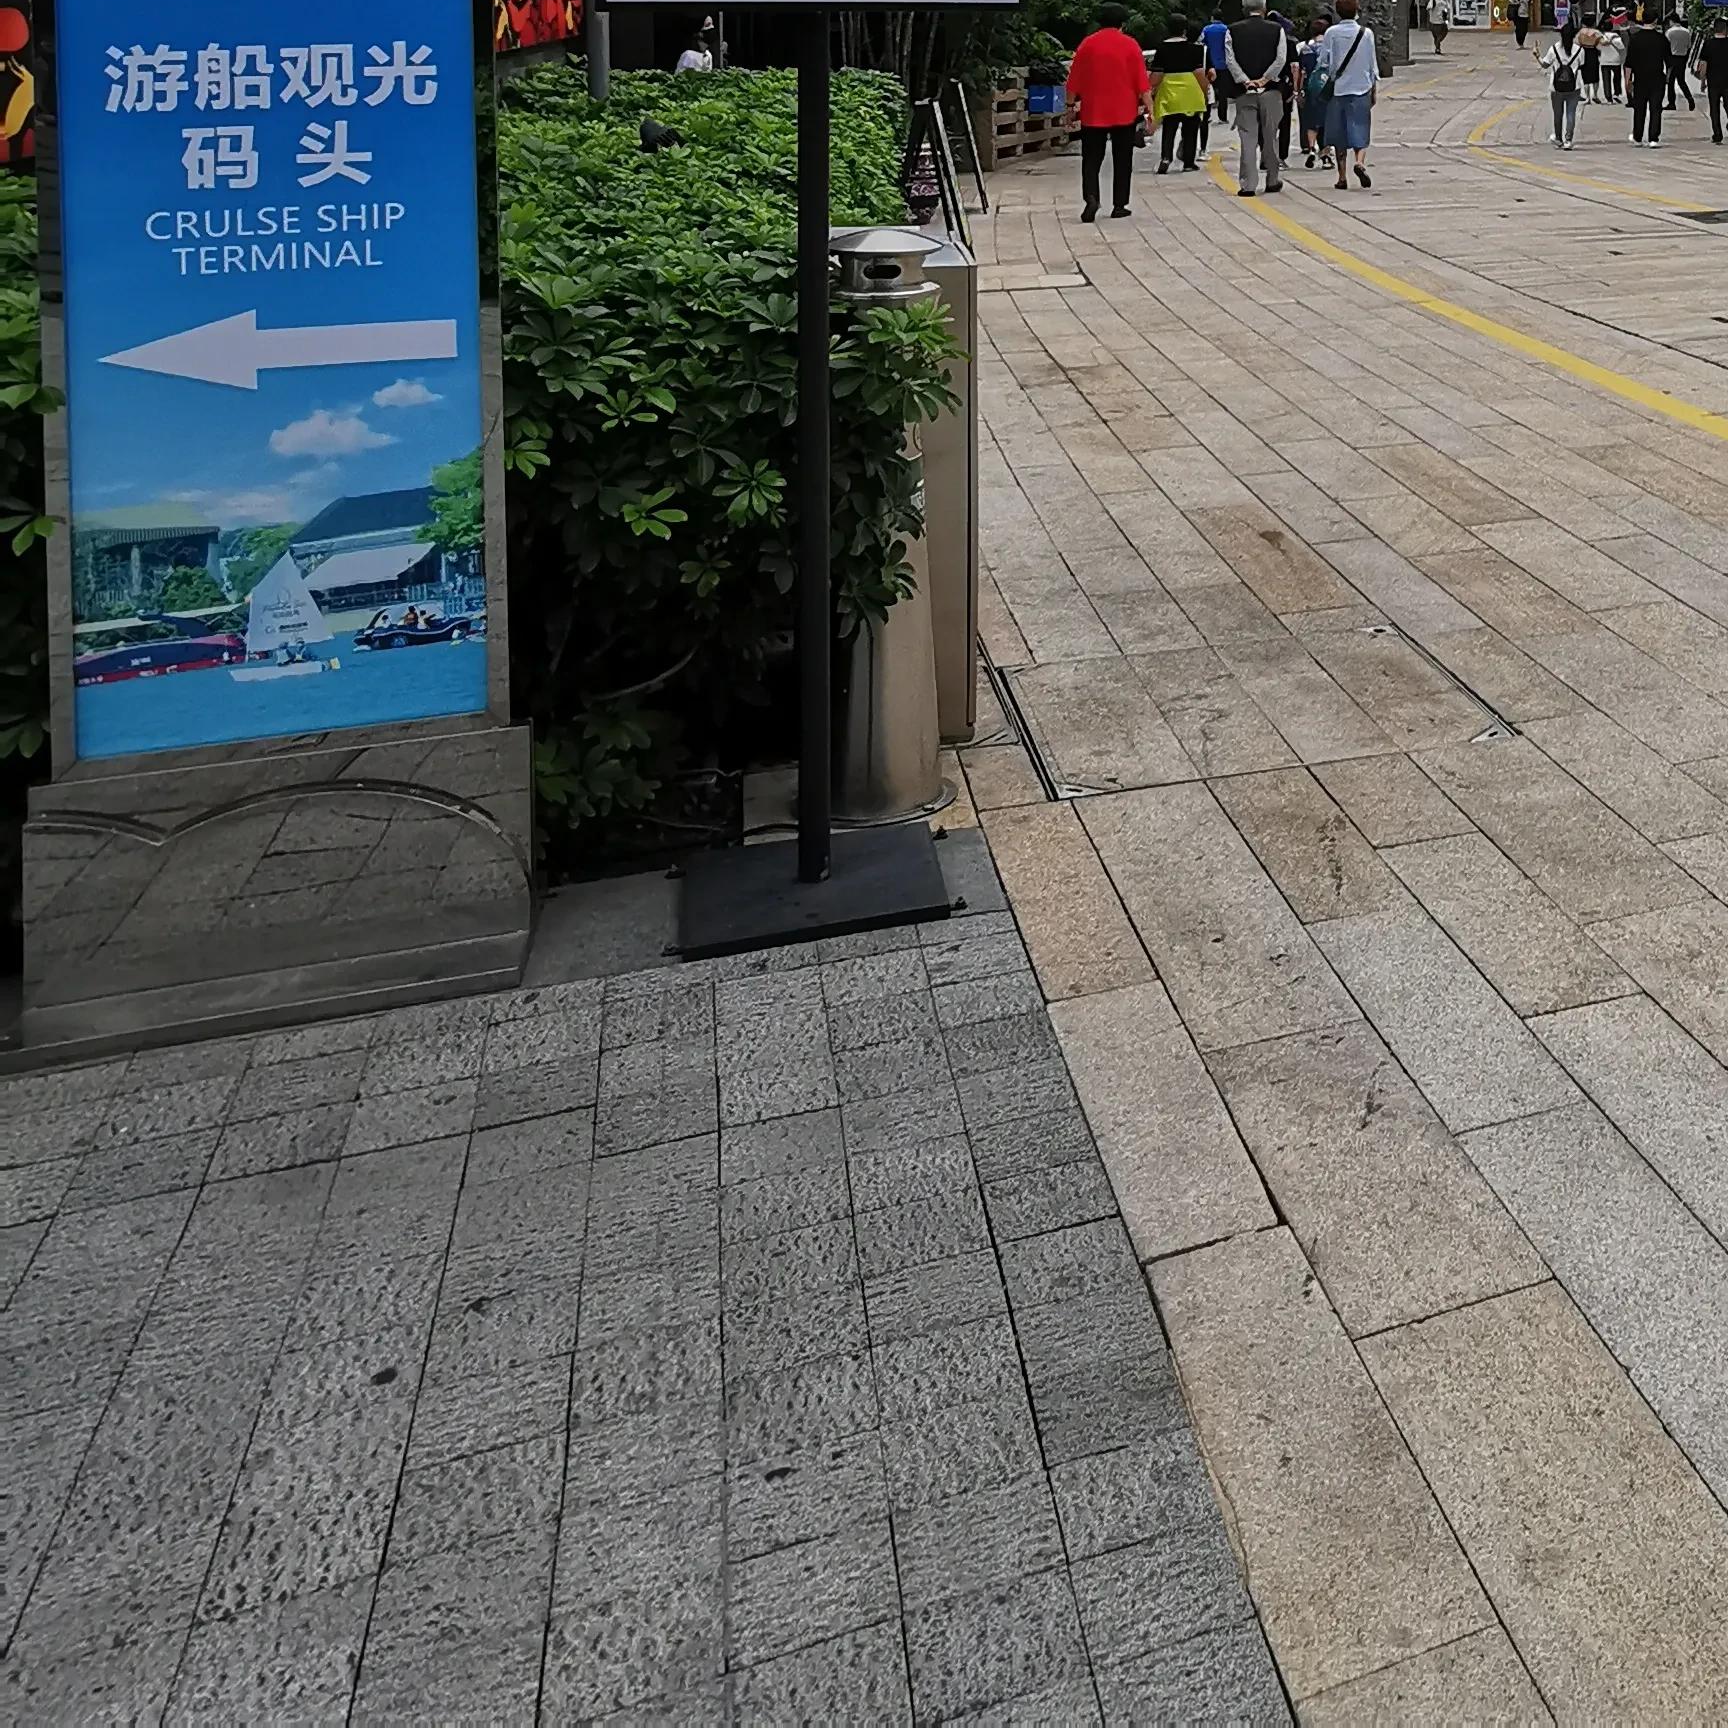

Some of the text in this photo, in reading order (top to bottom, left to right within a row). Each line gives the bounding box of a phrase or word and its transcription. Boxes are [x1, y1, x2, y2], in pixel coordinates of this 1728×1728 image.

[104, 41, 438, 113] 游船观光
[145, 202, 405, 240] CRULSE SHIP
[172, 239, 383, 275] TERMINAL
